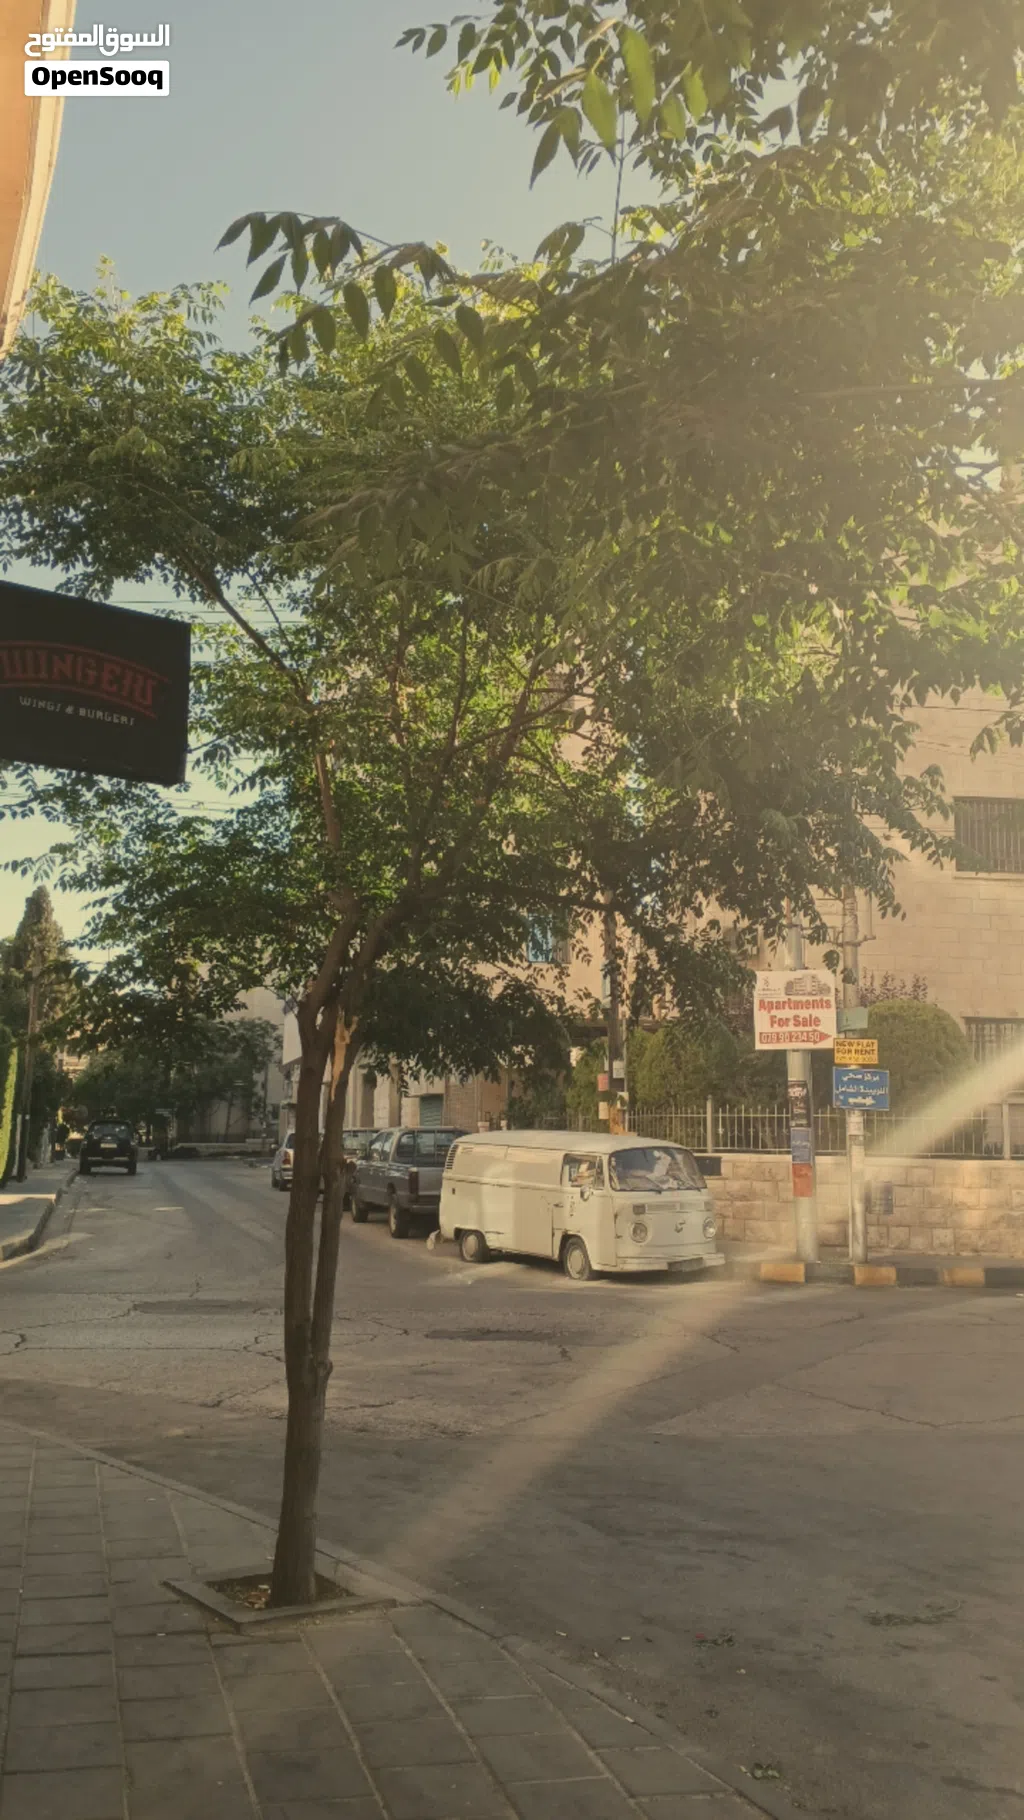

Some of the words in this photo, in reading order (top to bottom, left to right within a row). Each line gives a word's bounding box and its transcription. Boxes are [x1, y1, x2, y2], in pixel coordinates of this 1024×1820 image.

[19, 695, 62, 713] WINGS
[65, 703, 75, 715] &
[78, 707, 136, 727] BURGERS
[758, 997, 832, 1014] Apartments
[769, 1015, 790, 1029] For
[792, 1013, 821, 1028] Sale
[836, 1040, 855, 1048] NEW
[856, 1040, 876, 1049] FLAT
[836, 1048, 853, 1056] FOR
[854, 1048, 876, 1056] RENT
[842, 1072, 863, 1082] صحي
[864, 1072, 880, 1083] مركز
